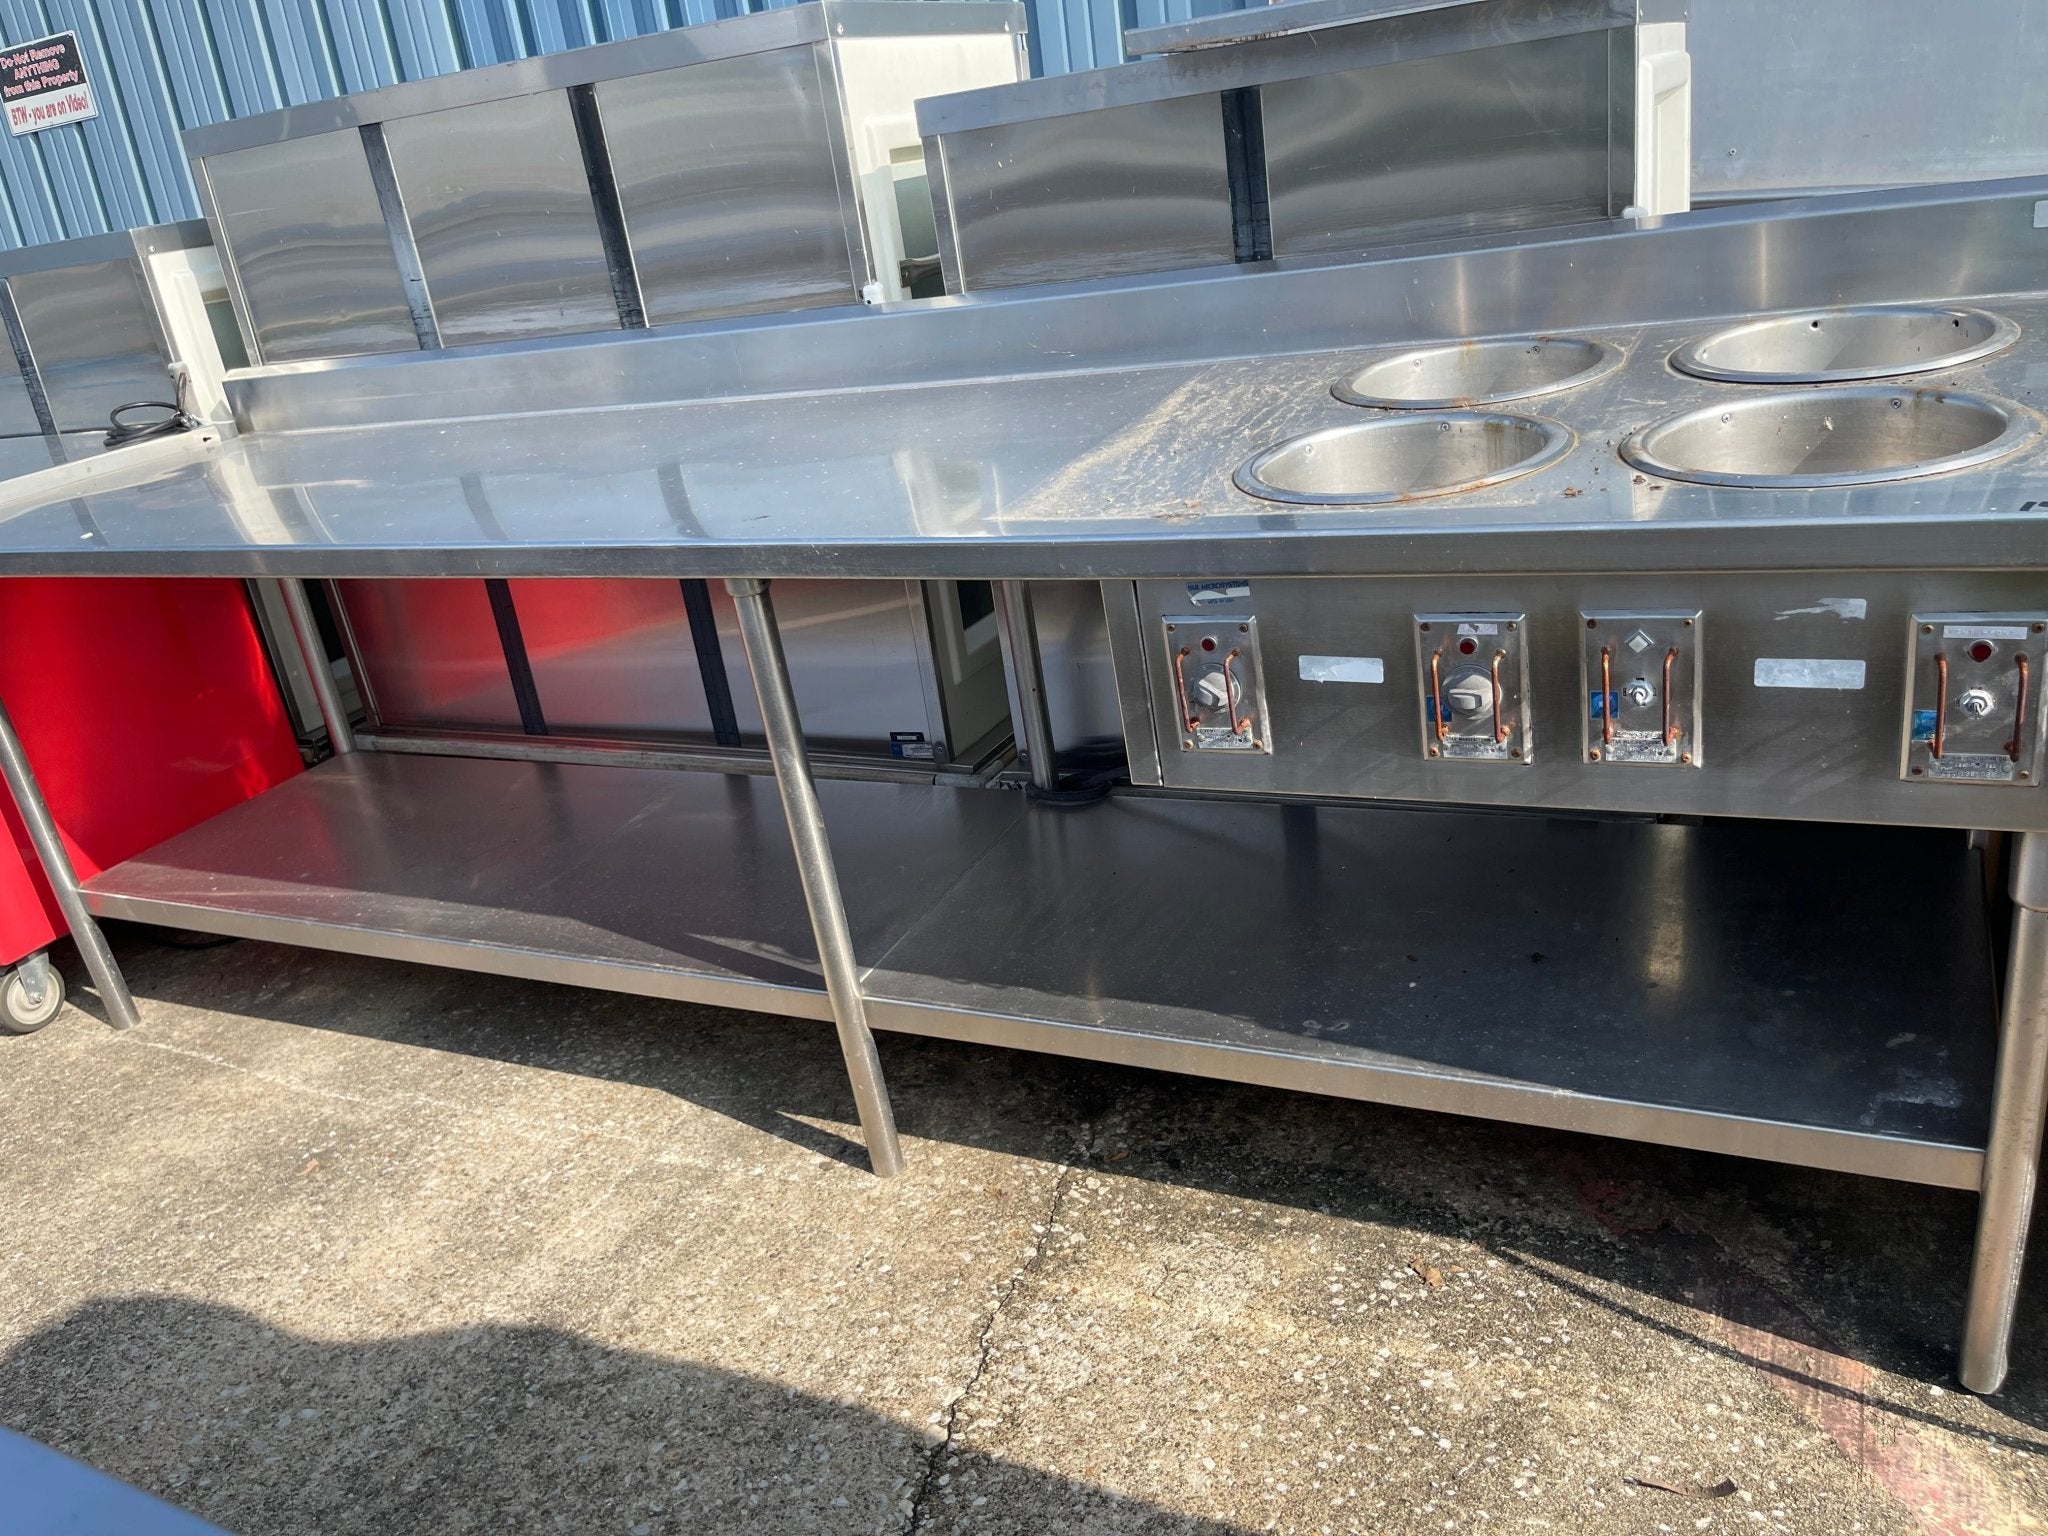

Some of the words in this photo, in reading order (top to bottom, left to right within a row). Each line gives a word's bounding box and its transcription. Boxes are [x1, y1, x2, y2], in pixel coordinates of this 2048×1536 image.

[0, 57, 13, 69] Do
[13, 51, 30, 65] Not
[29, 44, 65, 61] Remove
[14, 58, 60, 80] ANYTHING
[3, 84, 25, 97] from
[24, 79, 41, 92] this
[40, 69, 78, 88] Property
[11, 106, 28, 126] BTW
[32, 105, 46, 126] you
[45, 102, 57, 119] are
[57, 100, 68, 115] on
[65, 91, 89, 113] Video!
